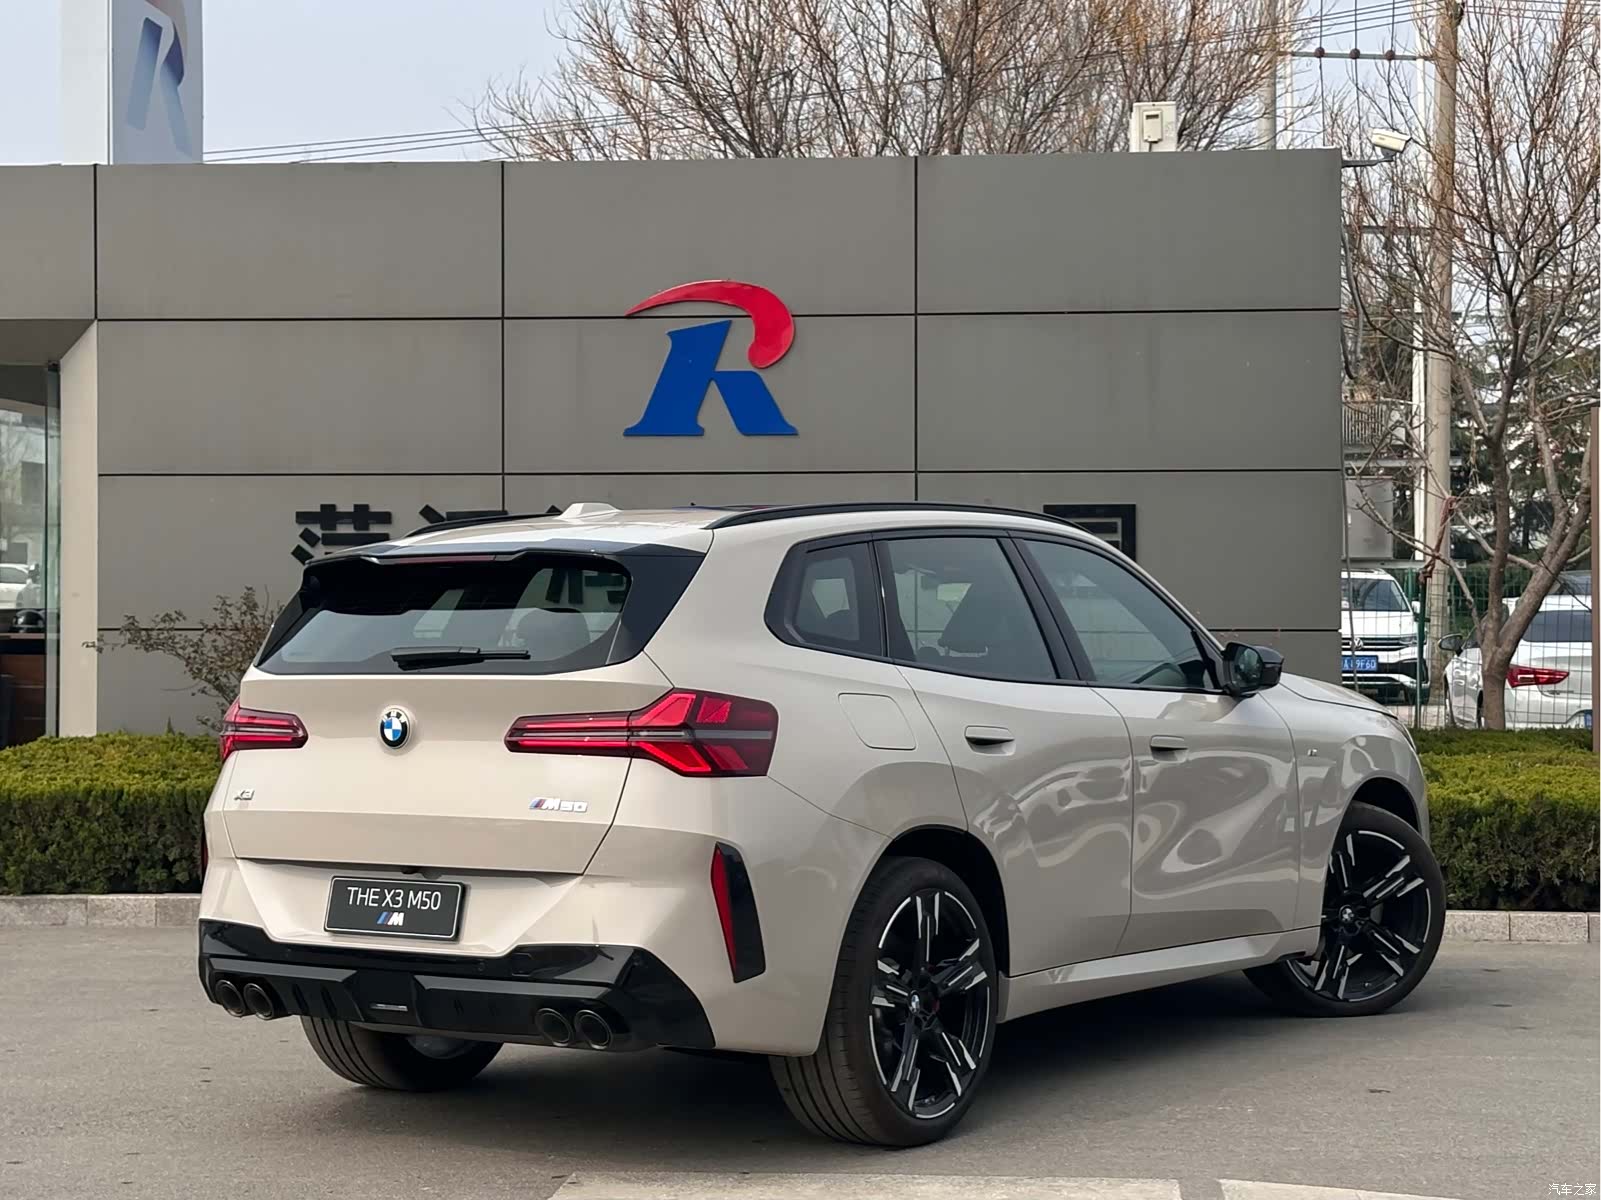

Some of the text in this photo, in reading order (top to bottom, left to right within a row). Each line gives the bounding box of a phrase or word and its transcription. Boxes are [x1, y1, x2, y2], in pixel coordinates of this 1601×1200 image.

[347, 887, 442, 911] THE X3 M50
